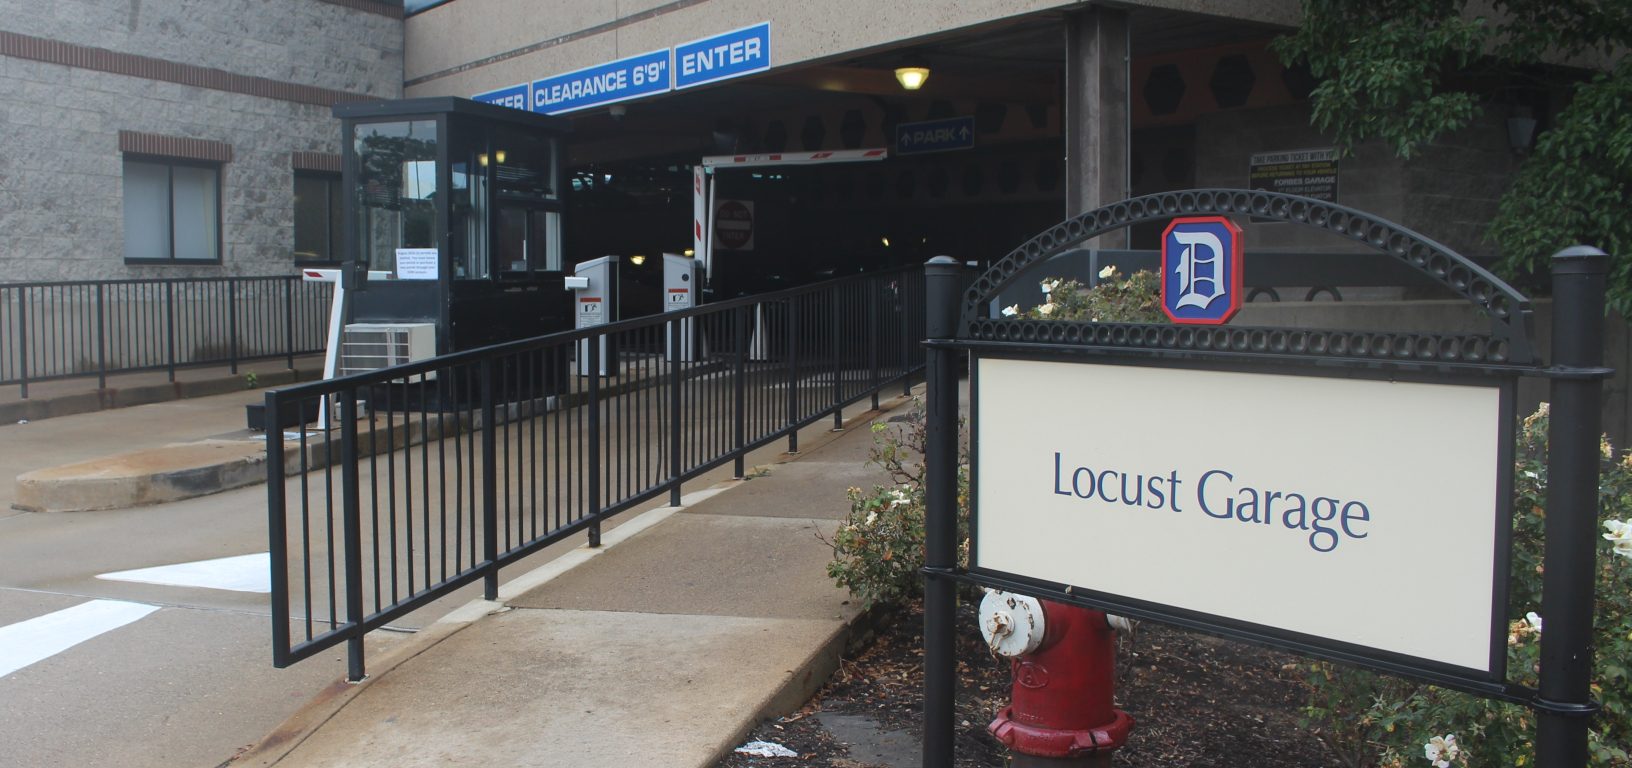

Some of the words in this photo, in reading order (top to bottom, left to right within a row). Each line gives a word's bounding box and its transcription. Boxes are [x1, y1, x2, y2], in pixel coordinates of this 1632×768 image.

[682, 37, 761, 77] ENTER
[535, 69, 627, 107] CLEARANCE
[633, 60, 667, 86] 6'9"
[914, 127, 956, 144] PARK
[1290, 152, 1309, 161] TICKET
[1274, 178, 1303, 187] FORBES
[1304, 176, 1336, 185] GARAGE
[1173, 231, 1226, 310] D
[1054, 451, 1183, 513] Locust
[1196, 469, 1370, 552] Garage
